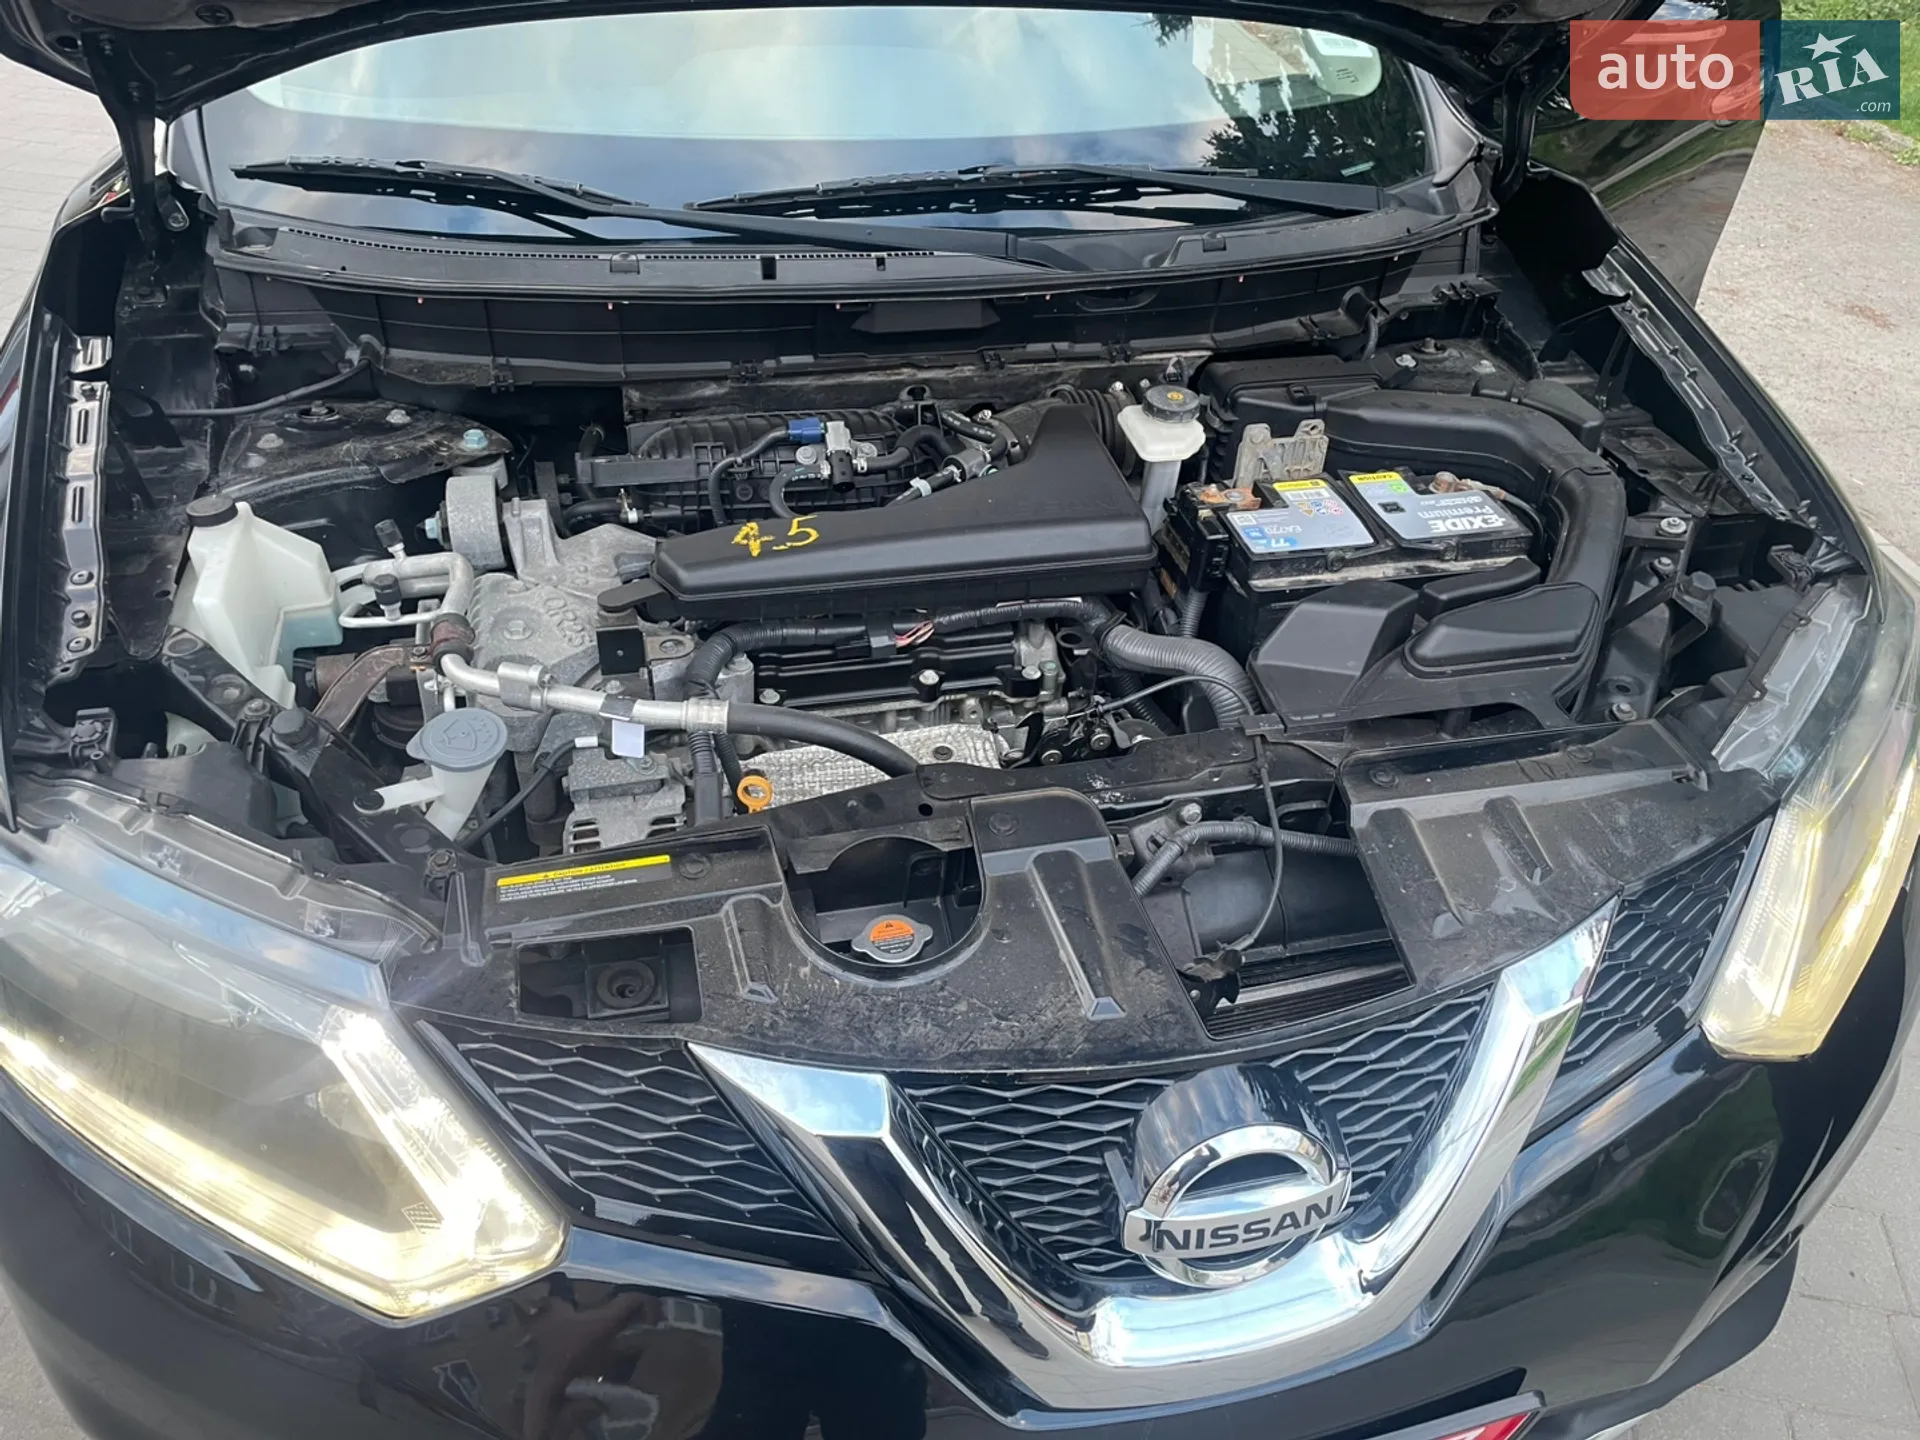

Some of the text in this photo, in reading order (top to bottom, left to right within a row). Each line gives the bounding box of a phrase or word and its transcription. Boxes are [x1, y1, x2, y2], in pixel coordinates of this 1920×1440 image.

[1417, 505, 1495, 519] Premium
[1428, 514, 1507, 533] EXIDE
[1155, 1195, 1334, 1251] NISSAN
